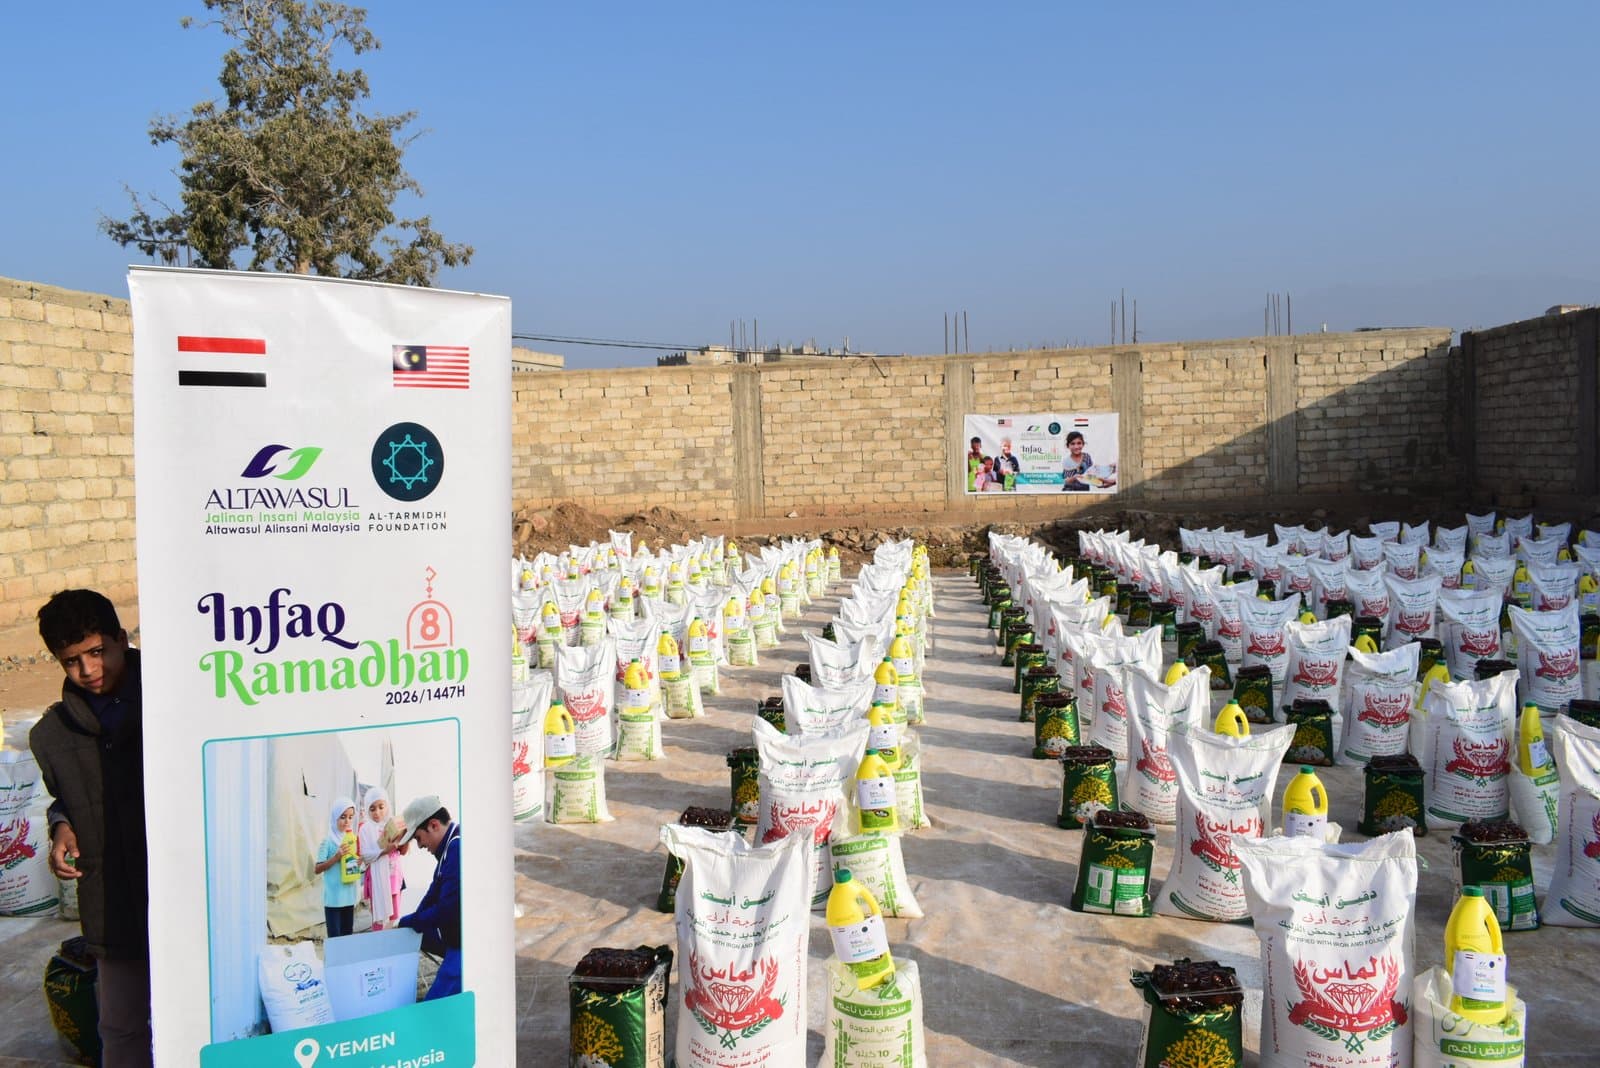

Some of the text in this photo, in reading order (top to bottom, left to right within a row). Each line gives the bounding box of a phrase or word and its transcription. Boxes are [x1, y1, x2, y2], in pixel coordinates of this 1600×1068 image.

[204, 487, 360, 510] ALTAWASUL
[205, 509, 360, 524] Jalinan Insani Malaysia
[368, 510, 447, 521] AL-TARMIDHI
[205, 522, 361, 535] Altawasul Alinsani Malaysia
[368, 522, 447, 532] FOUNDATION
[420, 607, 440, 641] 8
[199, 638, 469, 706] Ramadhan
[385, 685, 465, 705] 2026/1447H
[780, 799, 829, 818] الماس
[1207, 817, 1257, 834] الماس
[1292, 889, 1378, 910] دقيق أبيض
[701, 958, 765, 982] الماس
[1312, 955, 1386, 984] الماس
[696, 1002, 766, 1025] درجة أولى
[836, 1001, 907, 1018] سكر أبيض ناعم
[1308, 1010, 1391, 1028] درجة أولى
[325, 1031, 396, 1059] YEMEN
[879, 1049, 890, 1057] 10
[1447, 1043, 1477, 1054] ناعم
[1479, 1043, 1505, 1057] أبيض
